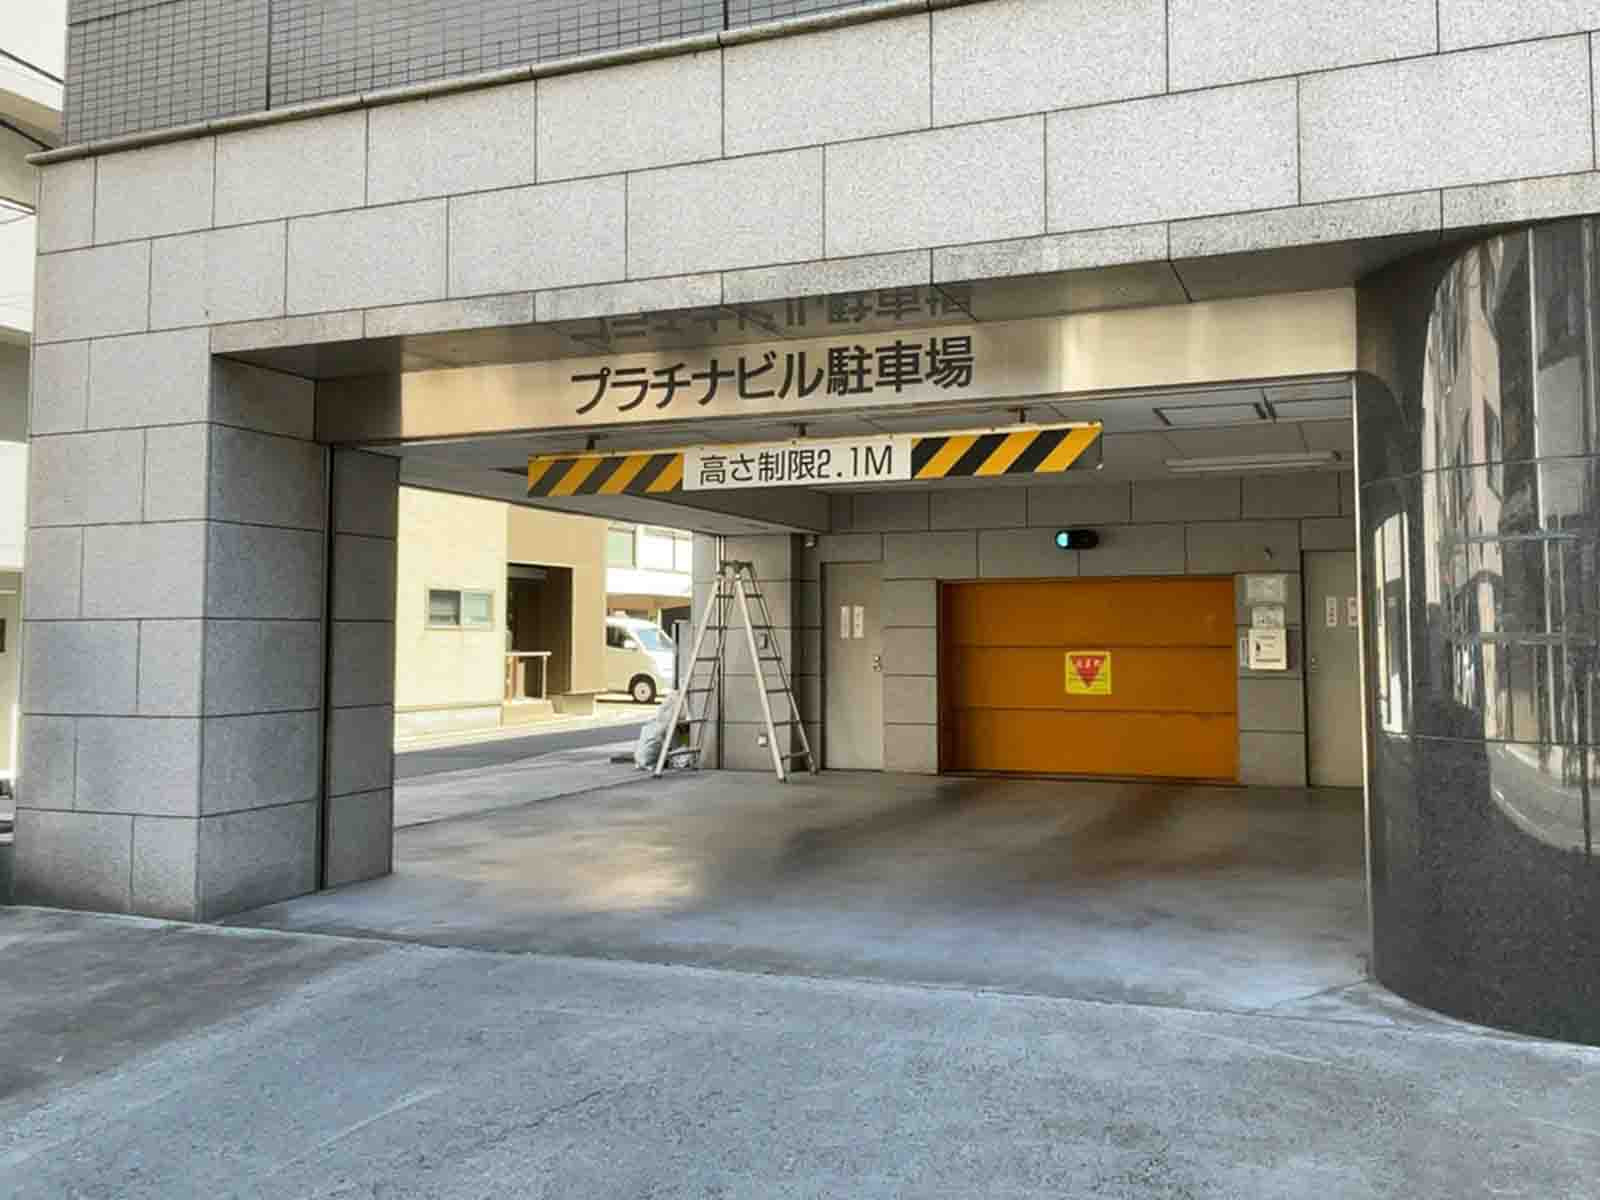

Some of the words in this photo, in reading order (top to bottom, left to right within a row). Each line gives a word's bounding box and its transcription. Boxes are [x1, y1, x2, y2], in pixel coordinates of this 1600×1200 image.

[571, 335, 974, 415] プラチナビル駐車場
[699, 444, 893, 486] 高さ制限2.1M
